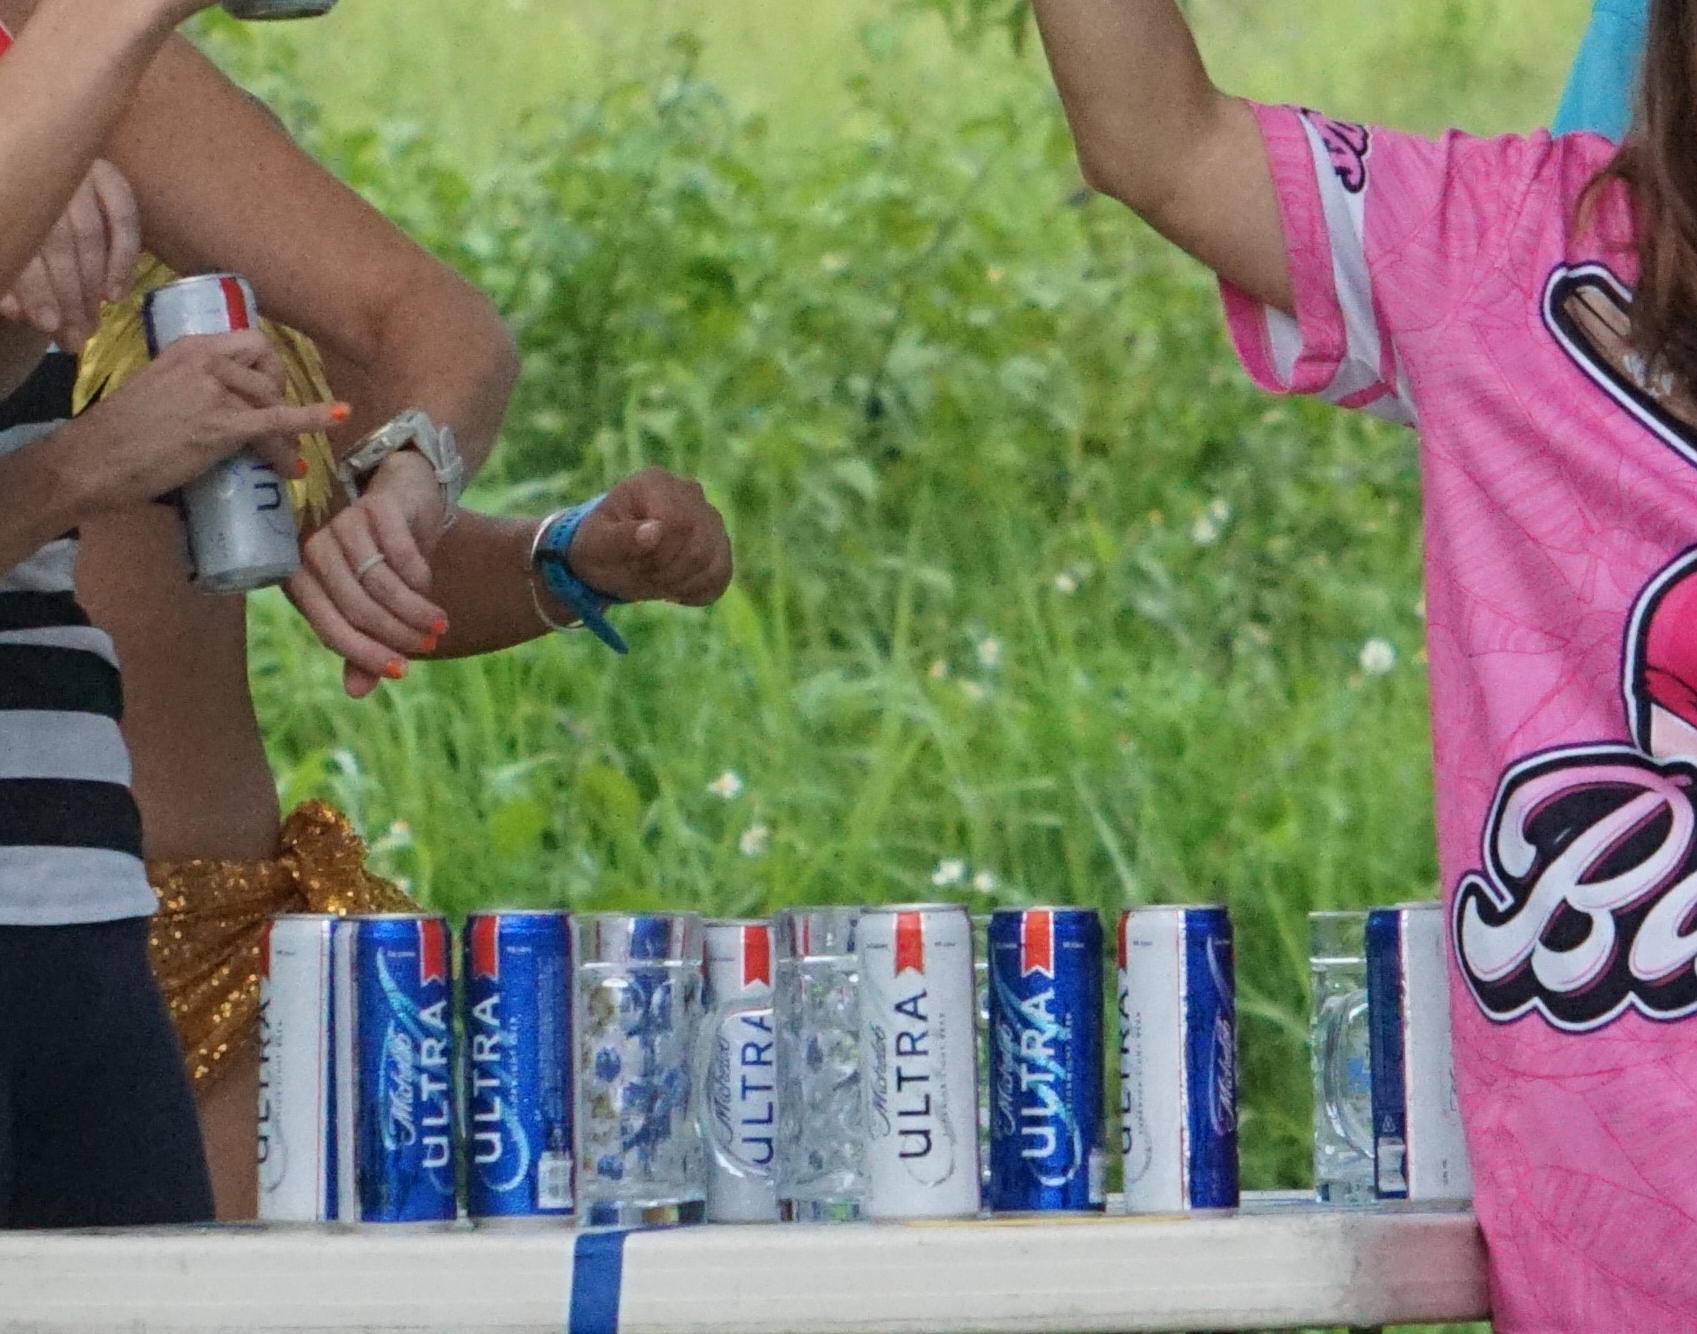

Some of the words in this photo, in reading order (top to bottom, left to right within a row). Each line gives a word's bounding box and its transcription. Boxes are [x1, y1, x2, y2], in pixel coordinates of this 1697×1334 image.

[419, 998, 451, 1169] ULTRA
[471, 991, 504, 1165] ULTRA
[740, 1014, 775, 1166] ULTRA
[893, 986, 934, 1160] ULTRA
[1020, 985, 1056, 1159] ULTRA
